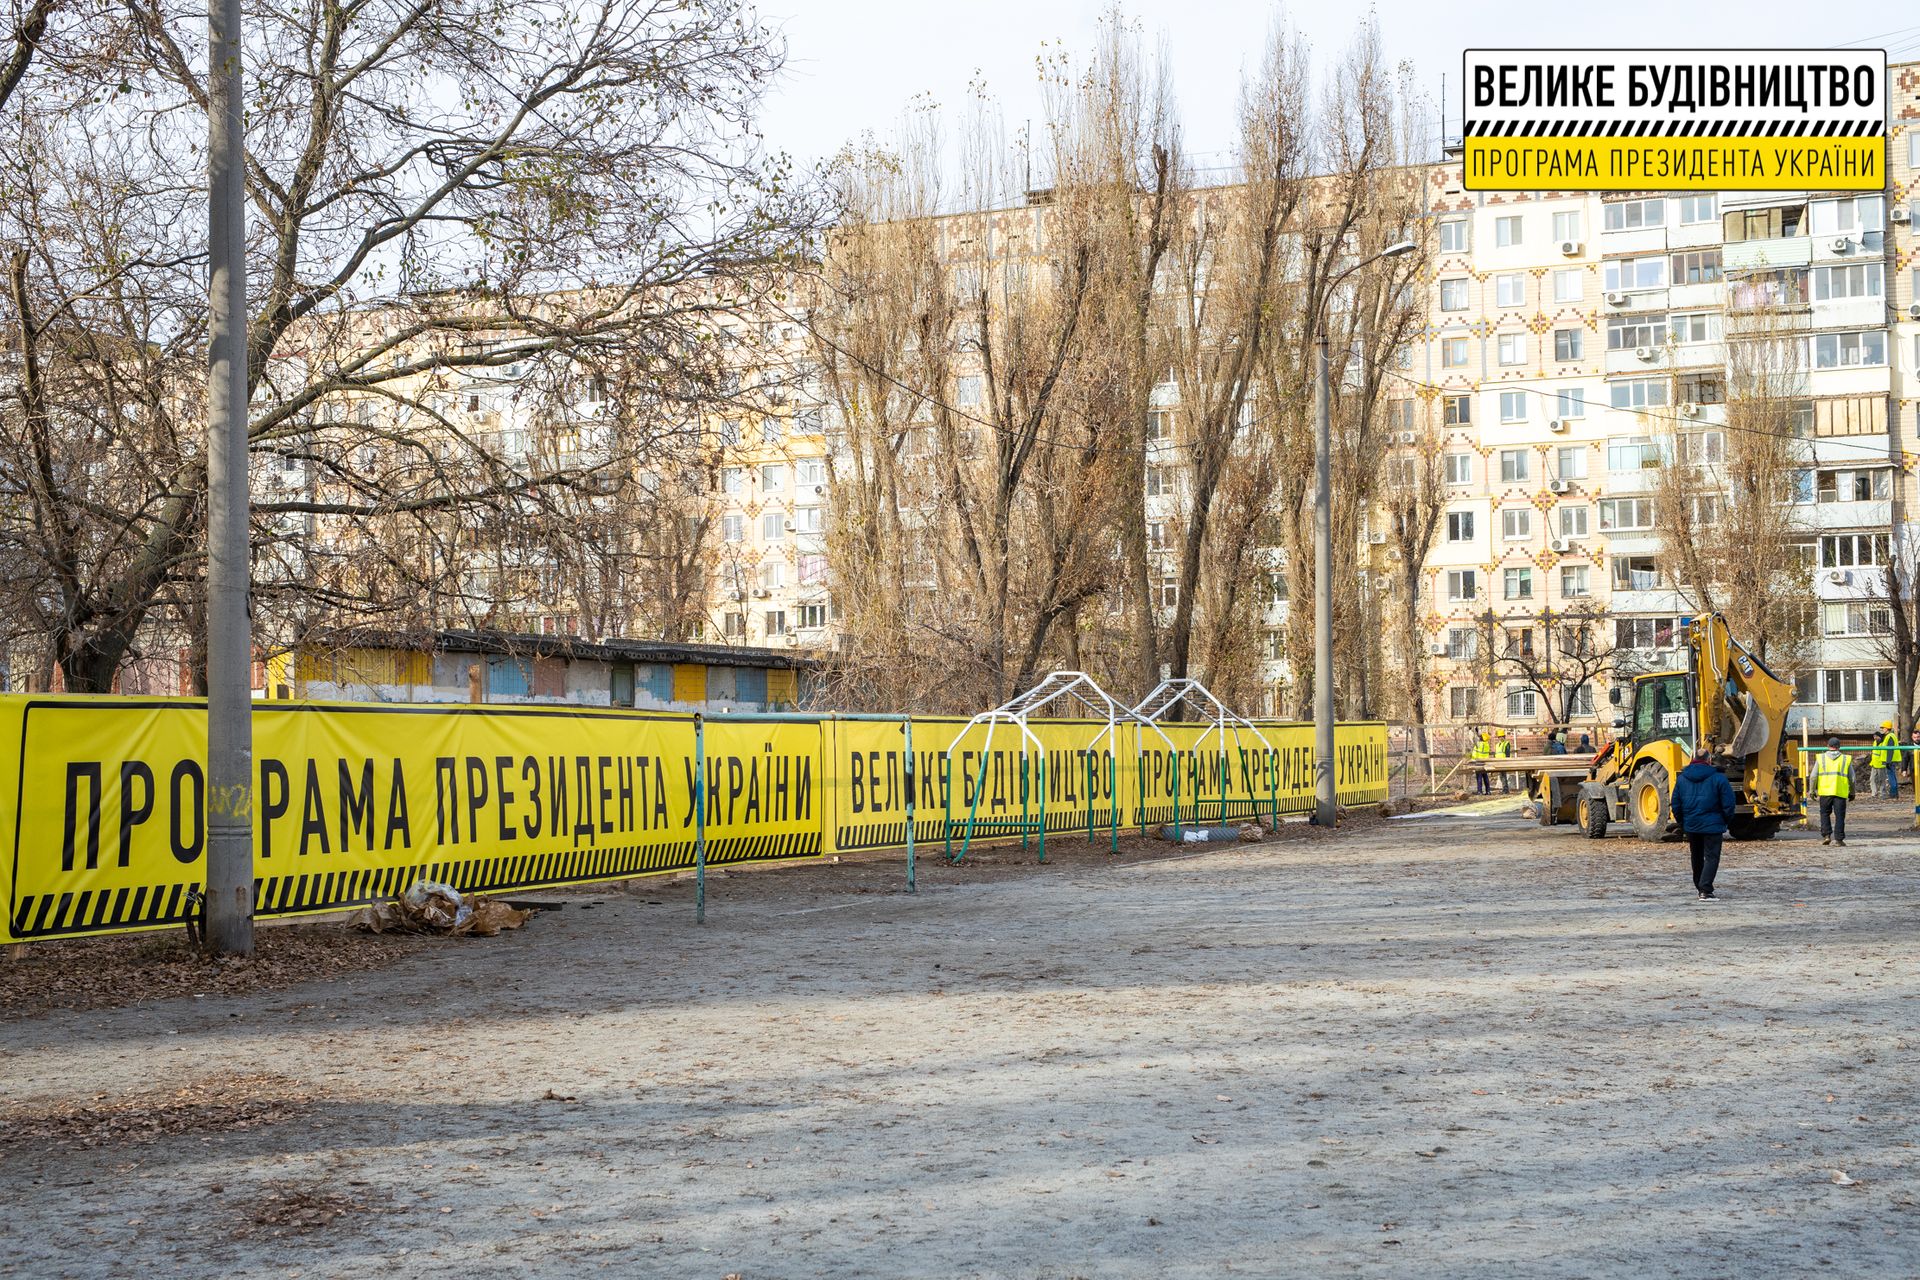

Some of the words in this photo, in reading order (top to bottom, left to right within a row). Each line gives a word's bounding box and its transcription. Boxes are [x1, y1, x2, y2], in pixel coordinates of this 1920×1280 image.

[1738, 655, 1754, 674] CAT
[1241, 747, 1316, 796] ПРЕЗИДЕН
[1339, 736, 1385, 786] УКРАЇНИ
[61, 758, 412, 872] ПРОРАМА
[435, 755, 668, 848] ПРЕЗИДЕНТА
[683, 742, 811, 828] УКРАЇНИ
